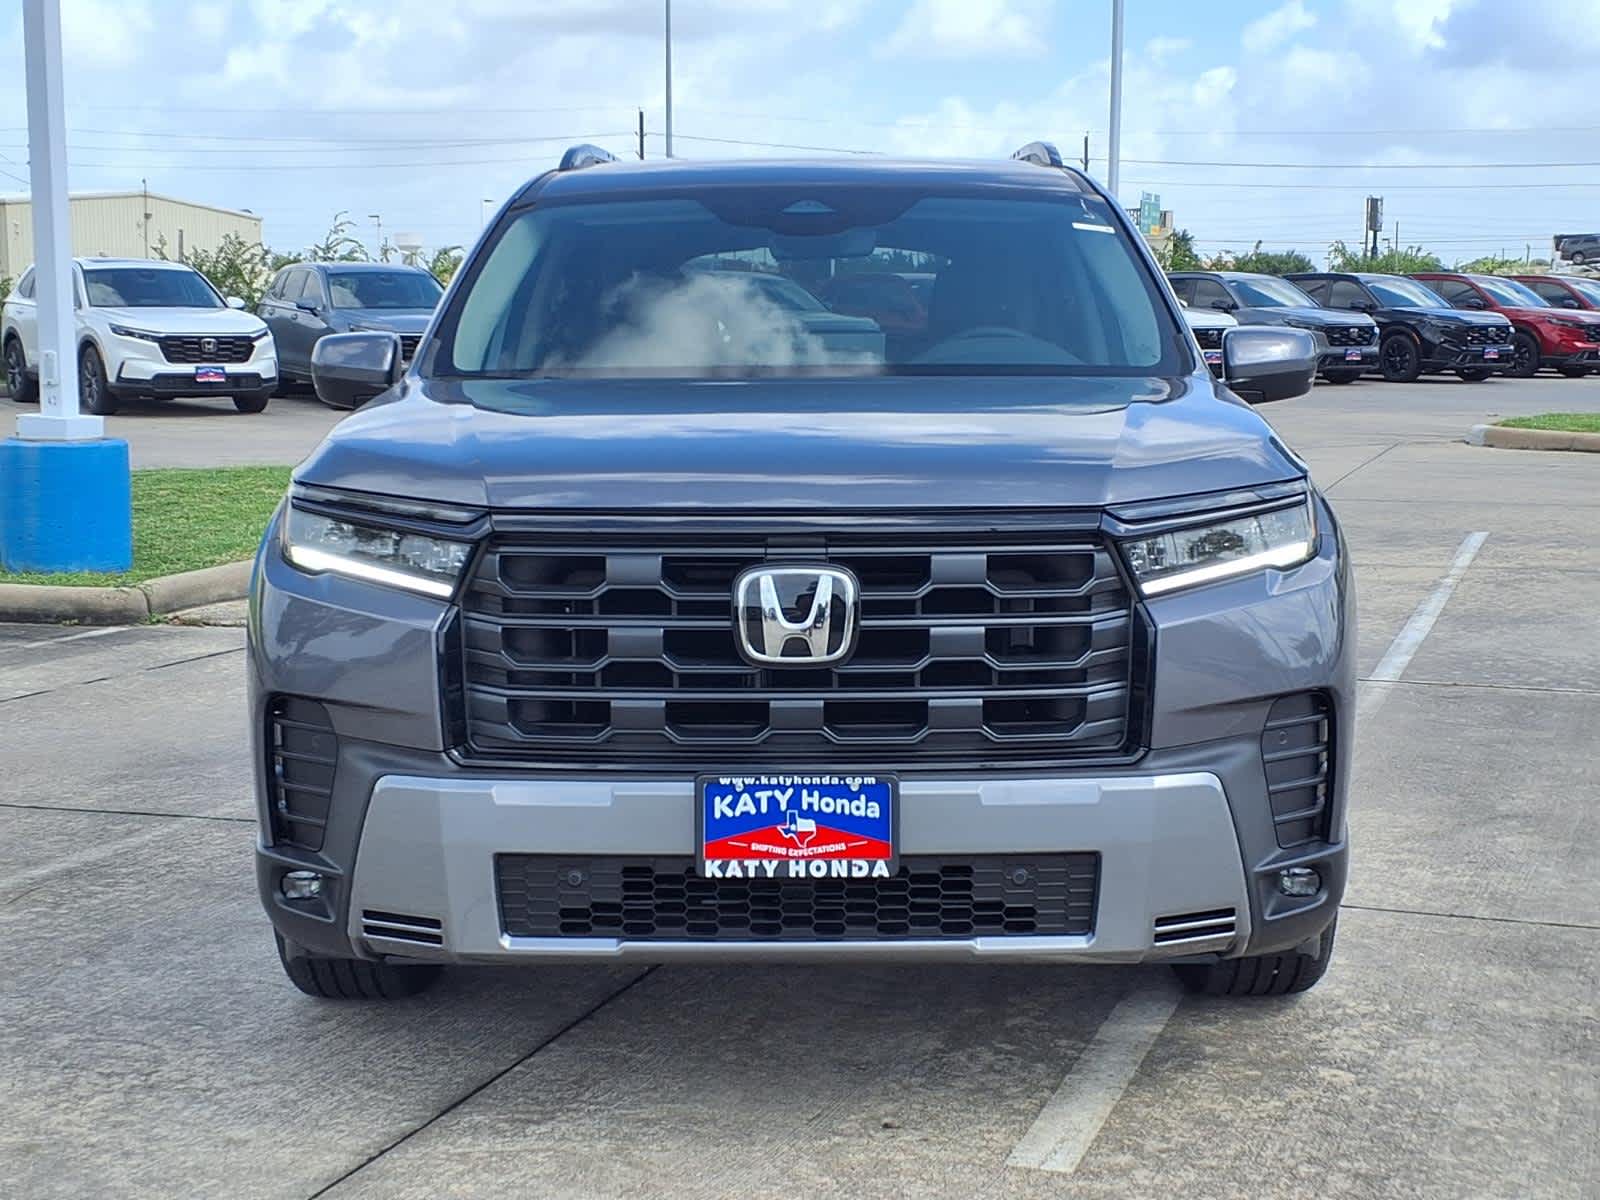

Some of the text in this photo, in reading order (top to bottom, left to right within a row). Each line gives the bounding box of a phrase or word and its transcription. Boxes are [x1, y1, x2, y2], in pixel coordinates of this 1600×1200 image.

[719, 775, 876, 786] www.katyhonda.com
[713, 787, 880, 819] KATY Honda
[750, 842, 847, 857] SHIFTING EXPECTATIONS
[705, 859, 890, 878] KATY HONDA
